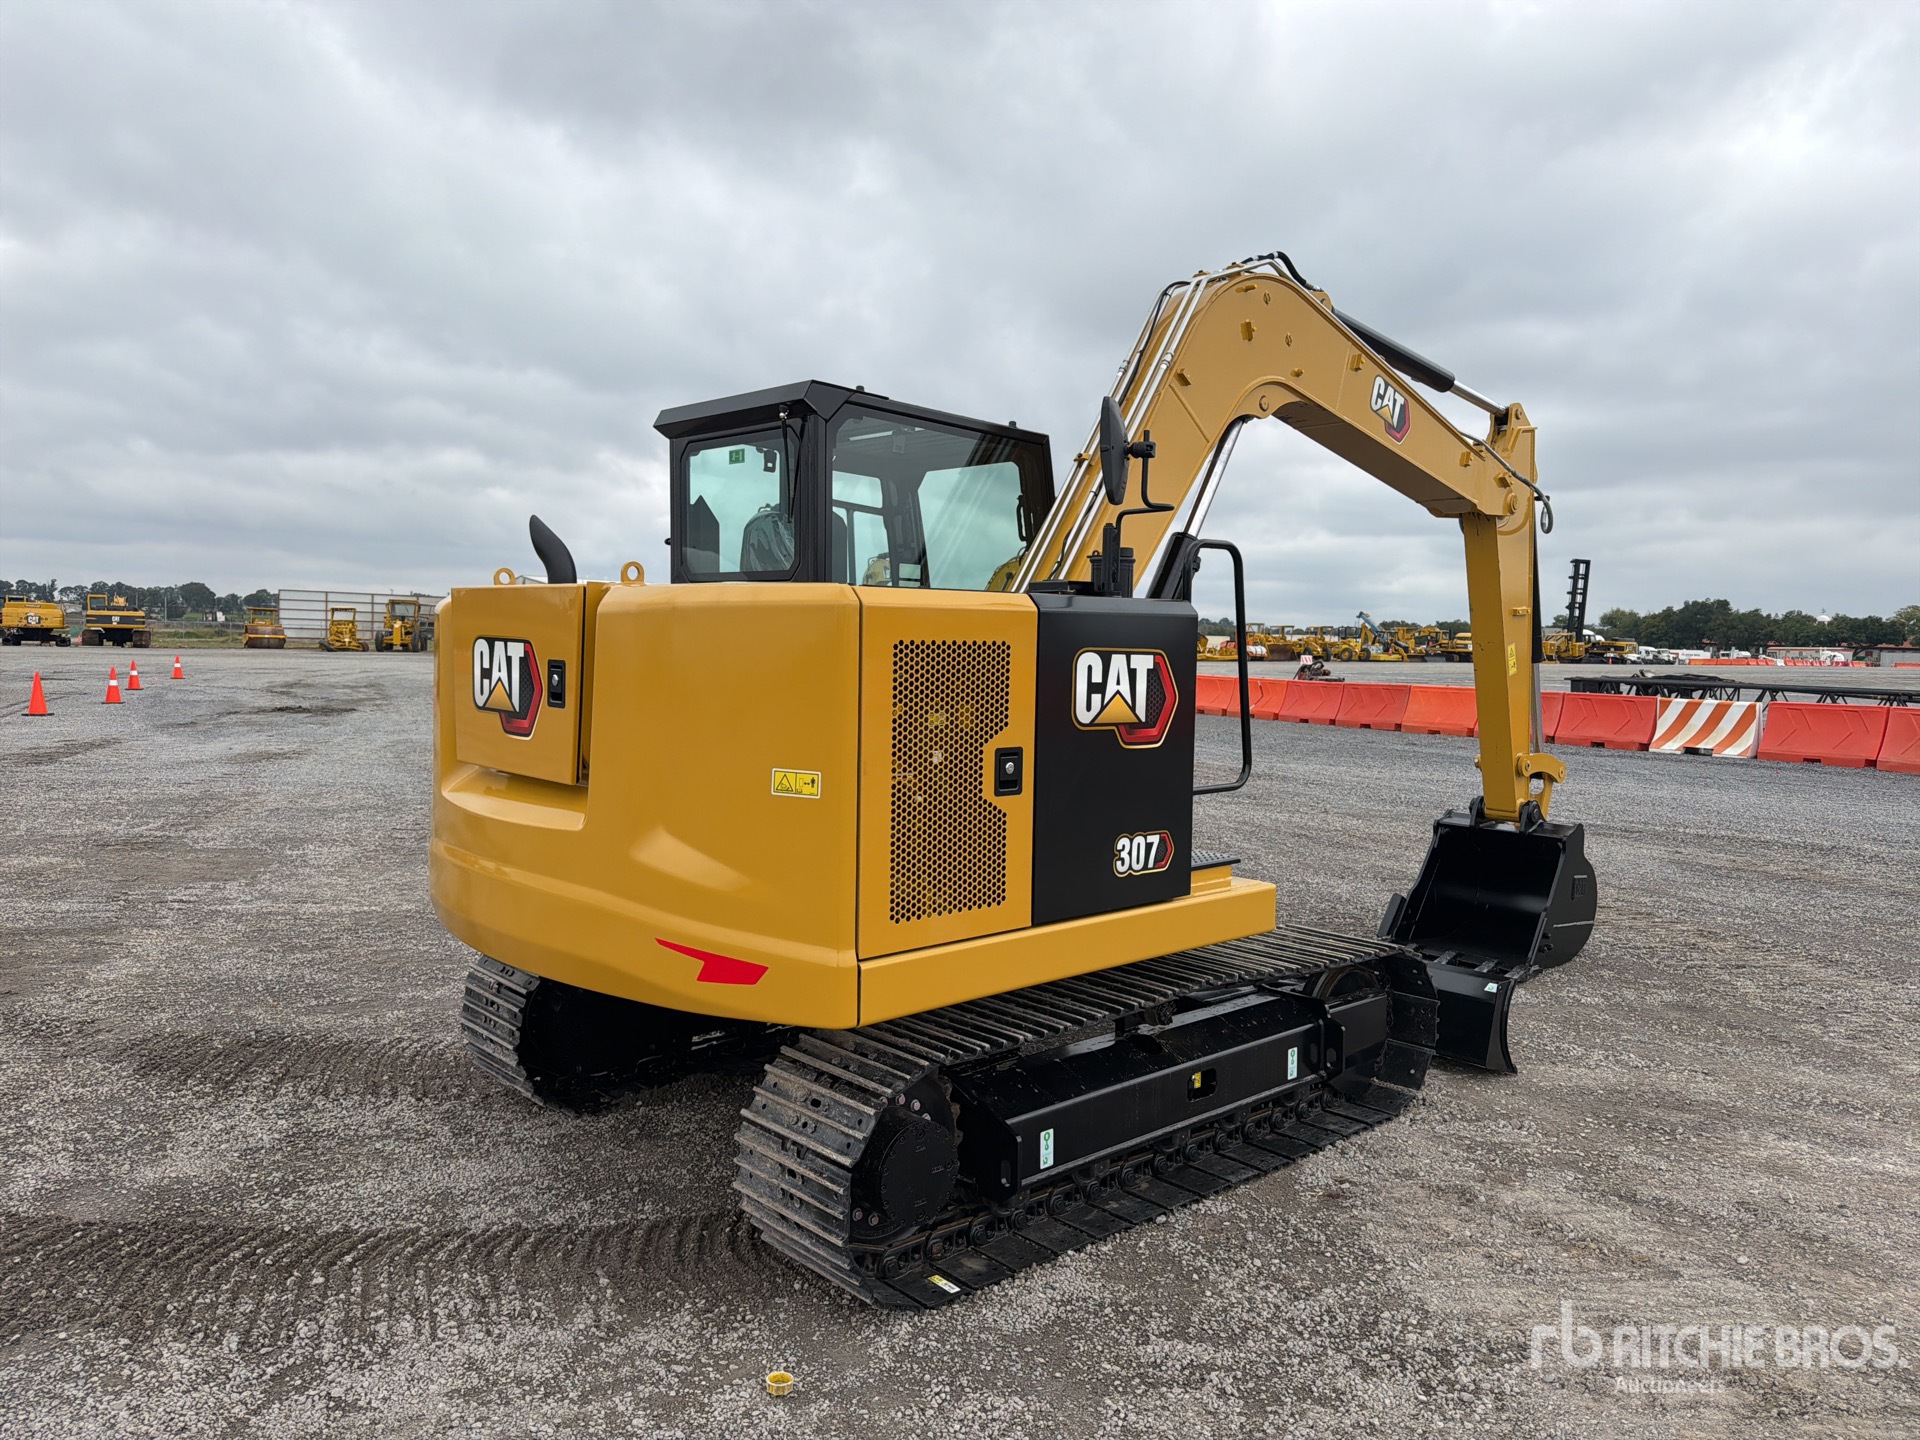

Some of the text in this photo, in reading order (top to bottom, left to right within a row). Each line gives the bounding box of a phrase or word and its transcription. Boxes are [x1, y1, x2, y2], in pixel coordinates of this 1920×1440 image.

[1371, 376, 1405, 428] CAT
[473, 637, 524, 712] CAT
[1075, 652, 1154, 724] CAT
[1116, 835, 1161, 873] 307
